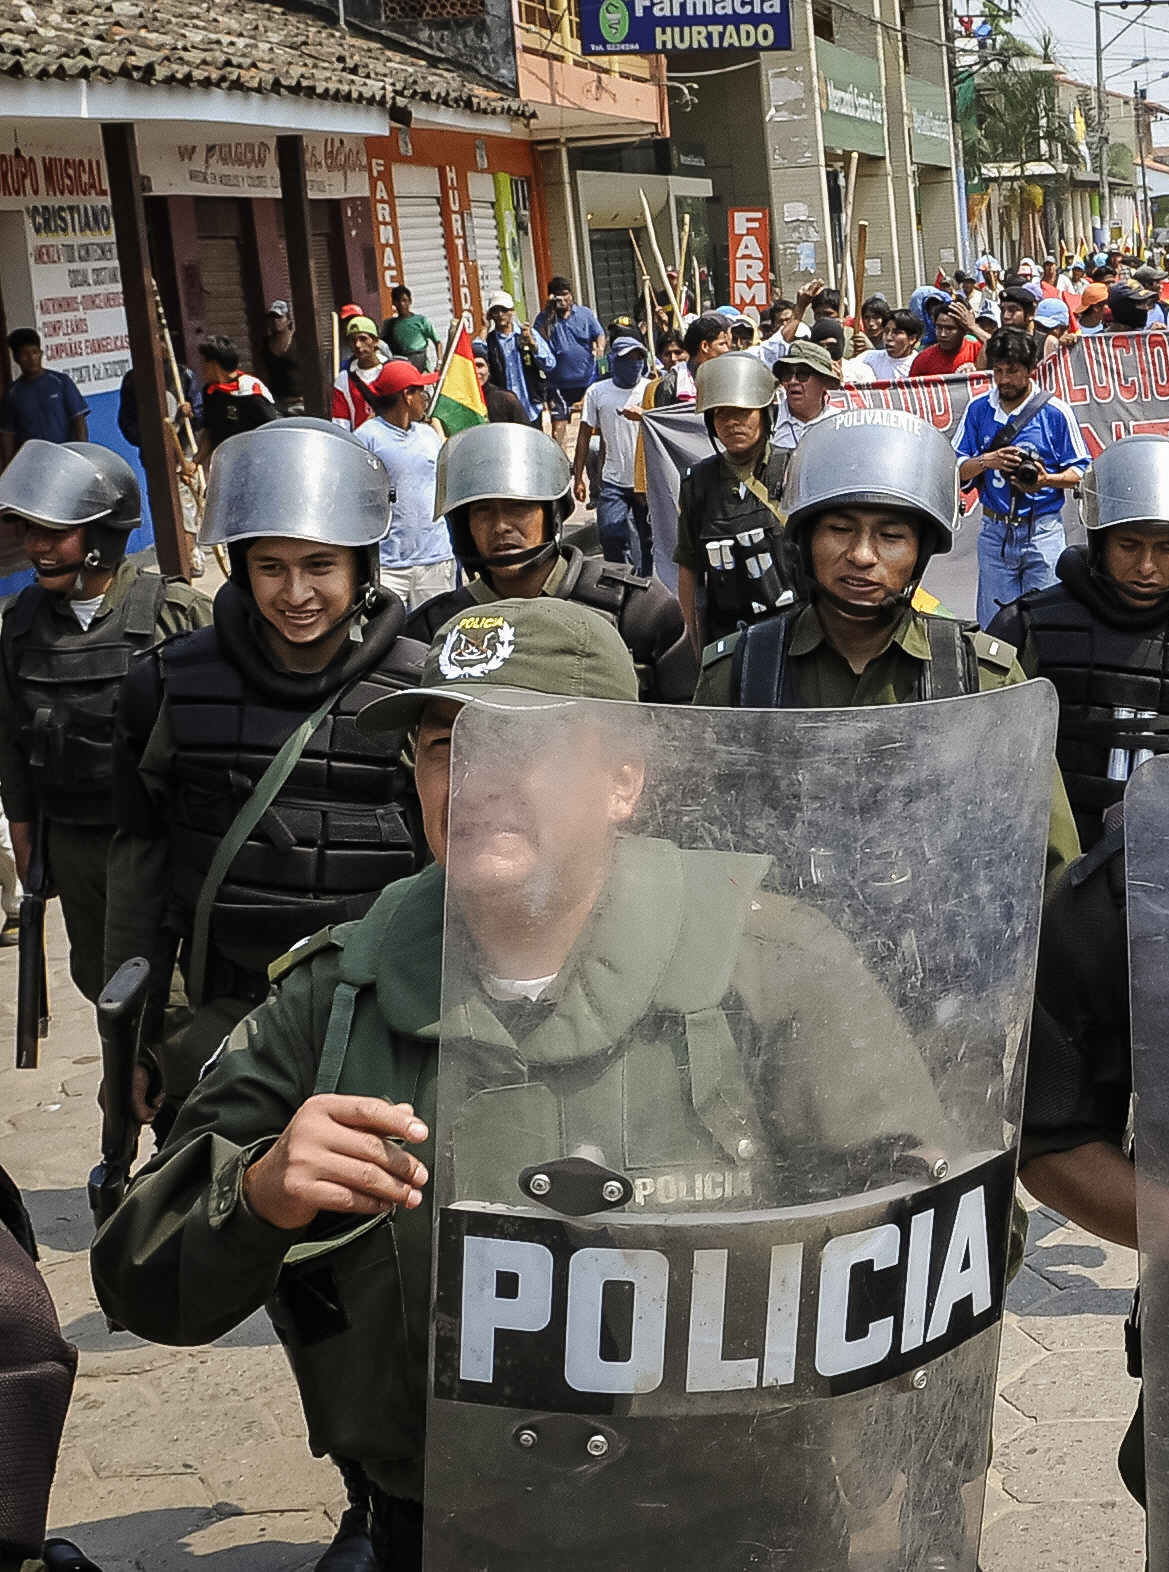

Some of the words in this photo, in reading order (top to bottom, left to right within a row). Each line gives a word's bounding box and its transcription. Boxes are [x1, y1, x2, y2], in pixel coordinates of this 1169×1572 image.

[655, 24, 775, 49] HURTADO
[42, 156, 109, 197] MUSICAL
[446, 165, 475, 334] HURTADO
[834, 408, 922, 437] POLIVALENTE
[459, 616, 505, 630] POLICIA
[459, 1185, 993, 1394] POLICIA
